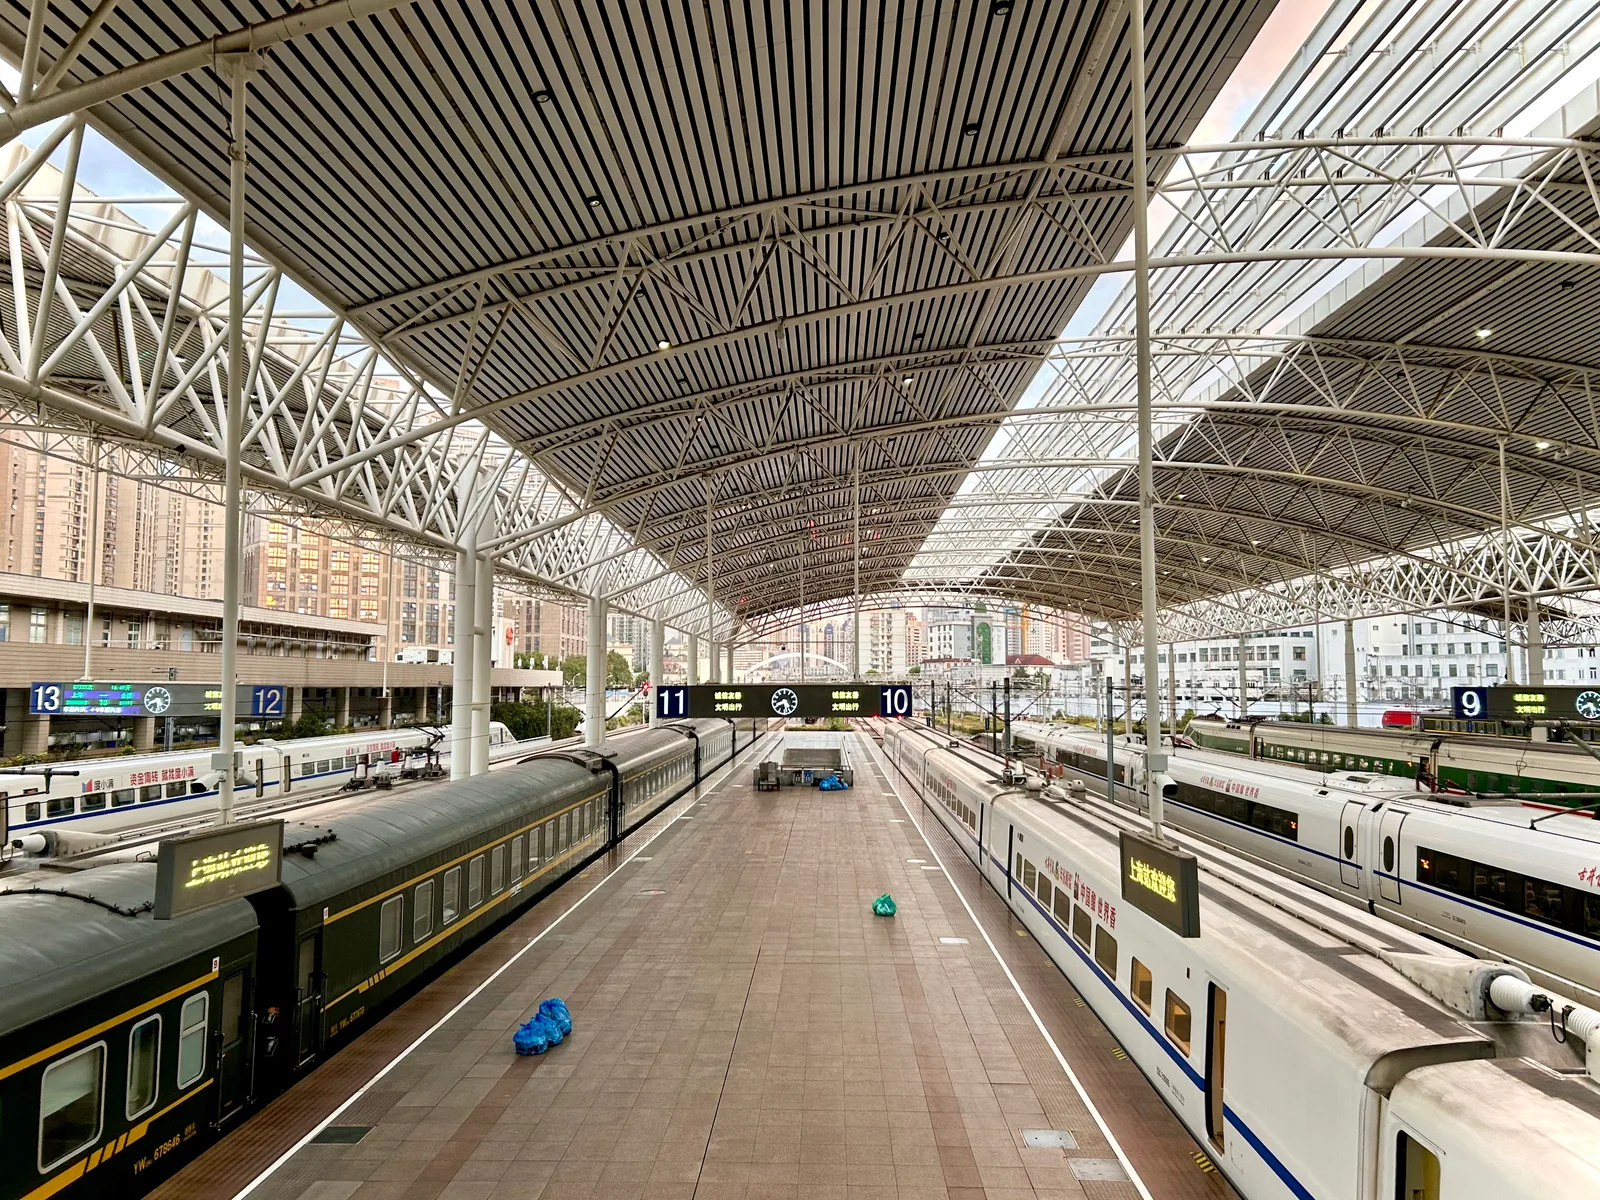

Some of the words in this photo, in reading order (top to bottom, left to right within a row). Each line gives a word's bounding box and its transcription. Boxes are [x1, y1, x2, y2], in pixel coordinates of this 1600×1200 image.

[34, 685, 60, 711] 13
[256, 689, 280, 714] 12
[660, 689, 684, 715] 11
[714, 702, 742, 711] 文明出行
[832, 702, 859, 711] 文明出行
[883, 689, 909, 714] 10
[1461, 691, 1481, 717] 9
[1514, 705, 1546, 714] 文明出行
[94, 779, 114, 791] 度小满
[130, 771, 158, 786] 资金周转
[161, 766, 194, 781] 就找度小满
[1129, 856, 1177, 903] 上海站欢迎您
[1098, 897, 1116, 930] 世界香
